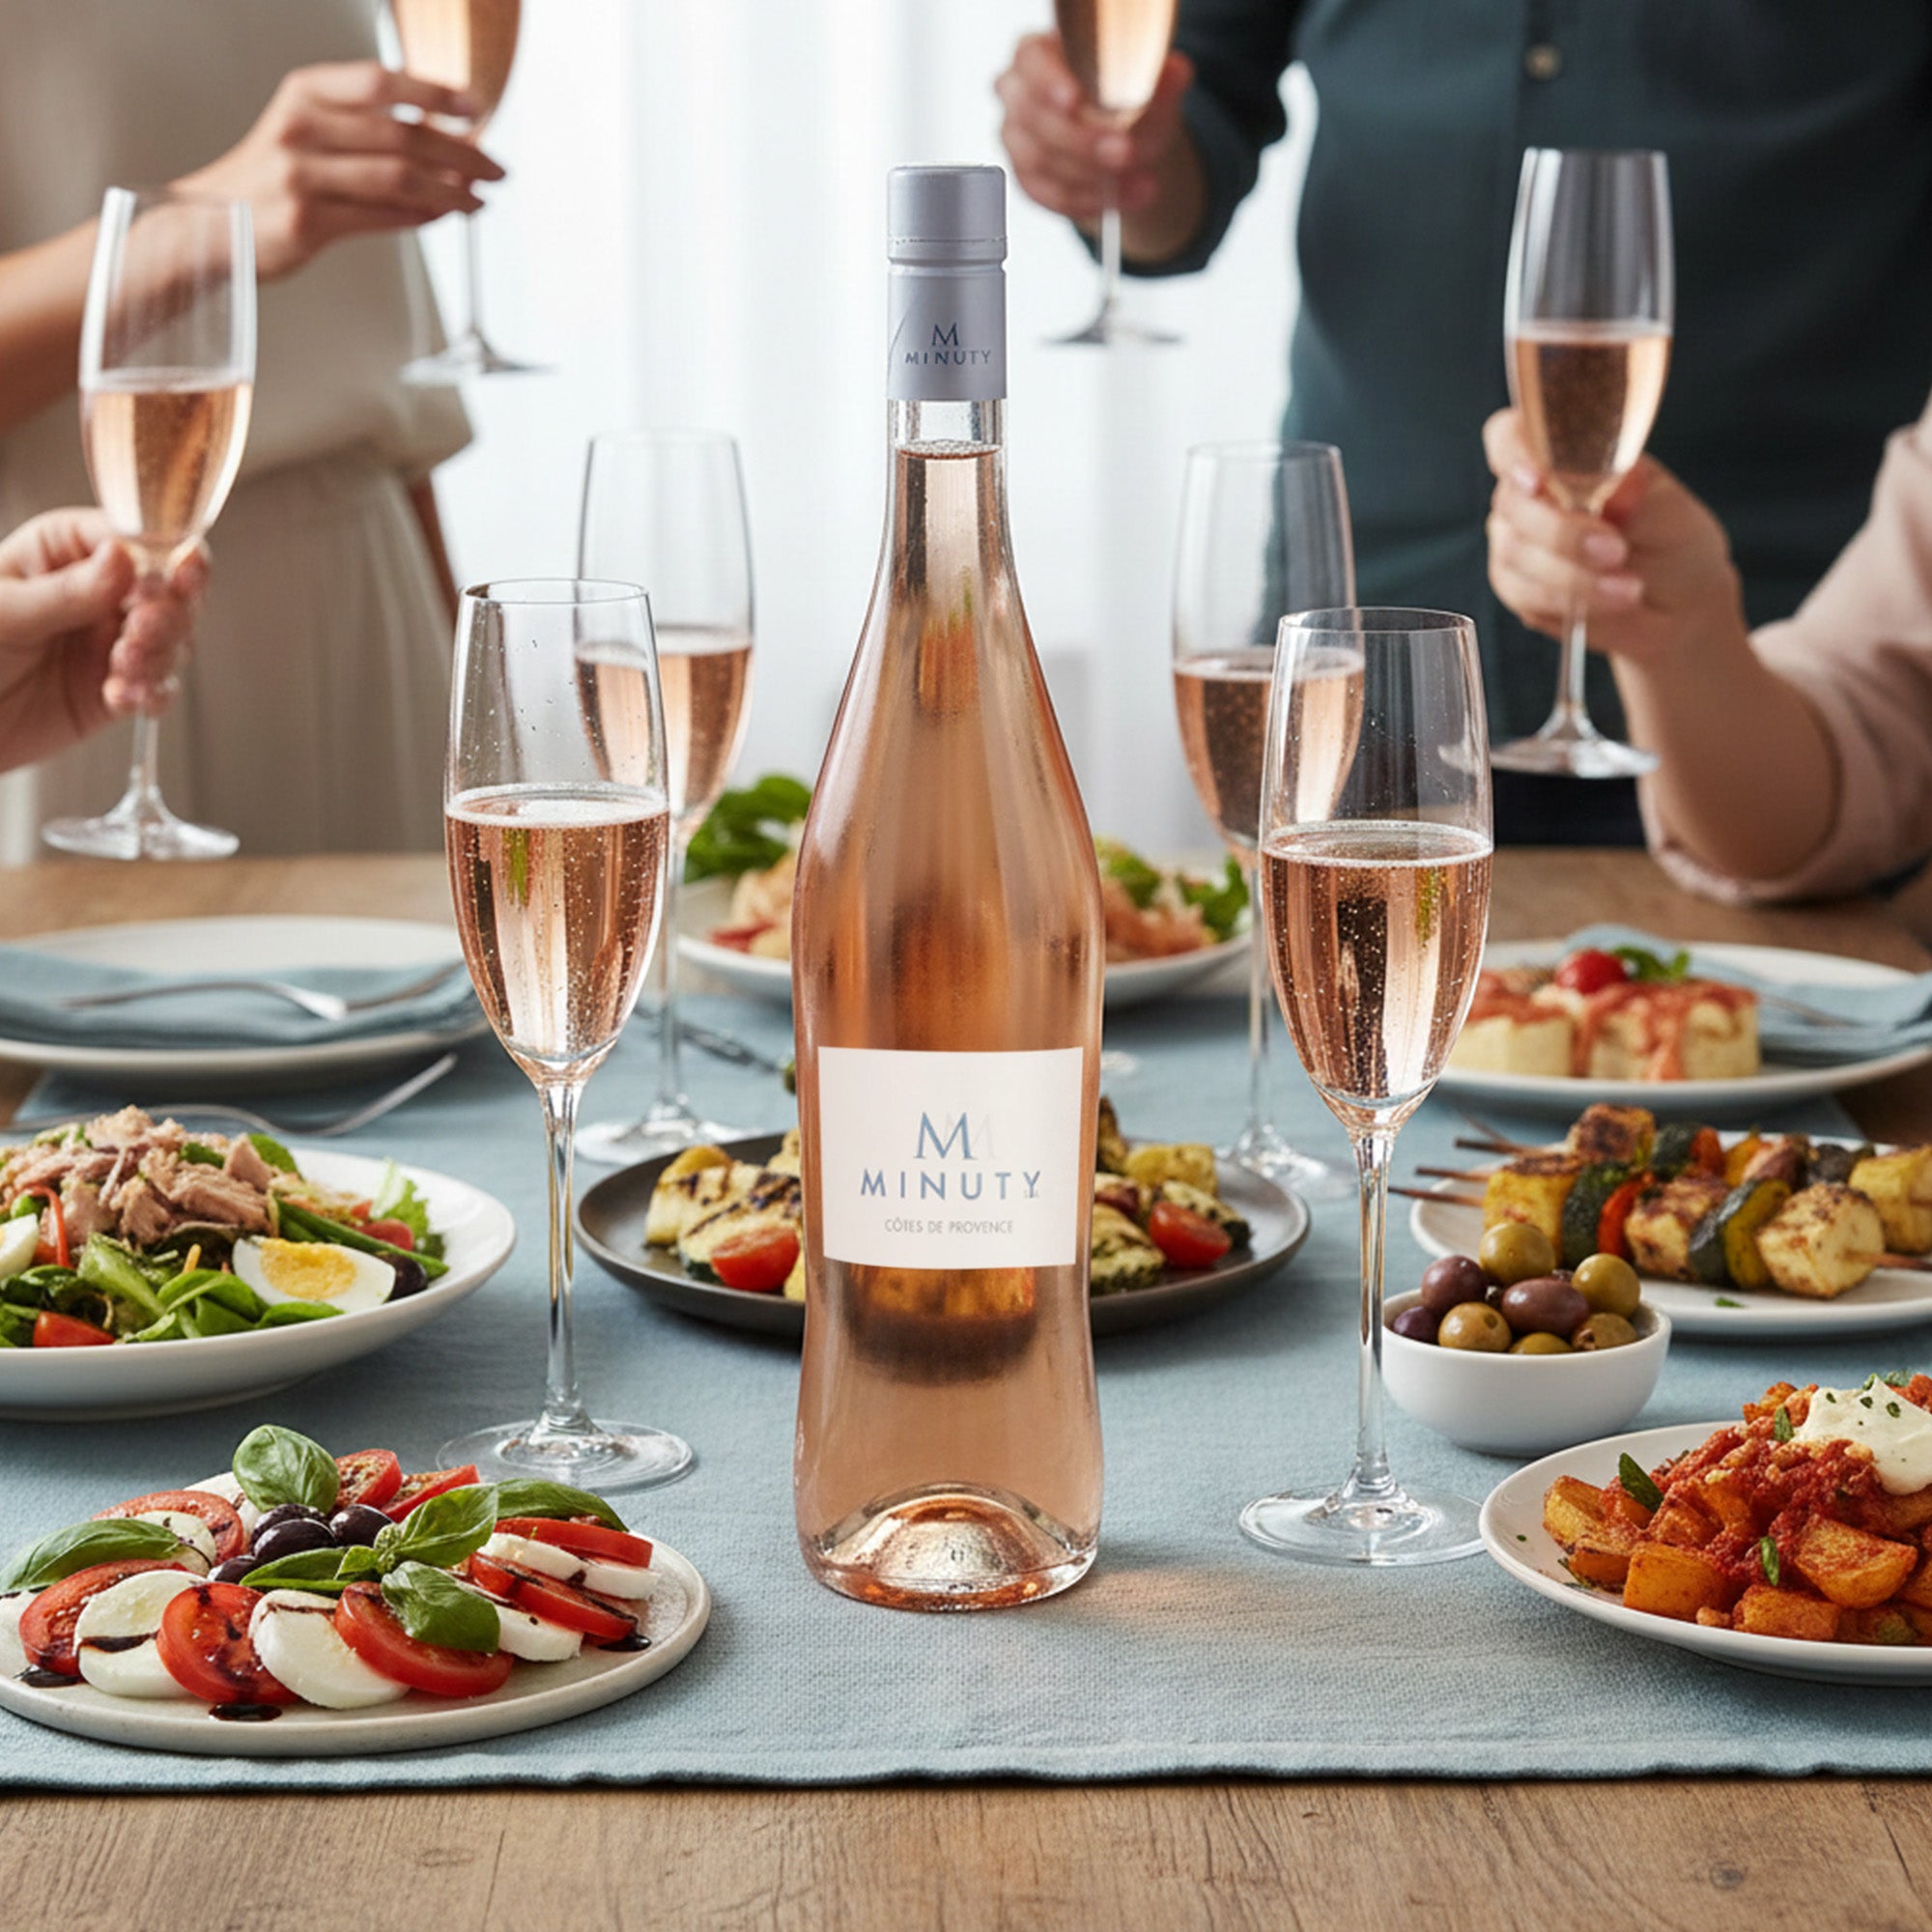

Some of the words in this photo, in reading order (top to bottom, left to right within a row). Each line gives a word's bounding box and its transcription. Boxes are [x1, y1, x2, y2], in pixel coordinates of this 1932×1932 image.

[932, 323, 959, 347] M
[905, 350, 991, 365] MINUTY
[914, 1112, 977, 1160] M
[861, 1168, 1040, 1200] MINUTY
[885, 1216, 923, 1234] CÔTES
[927, 1220, 944, 1234] DE
[949, 1220, 1013, 1234] PROVENCE
